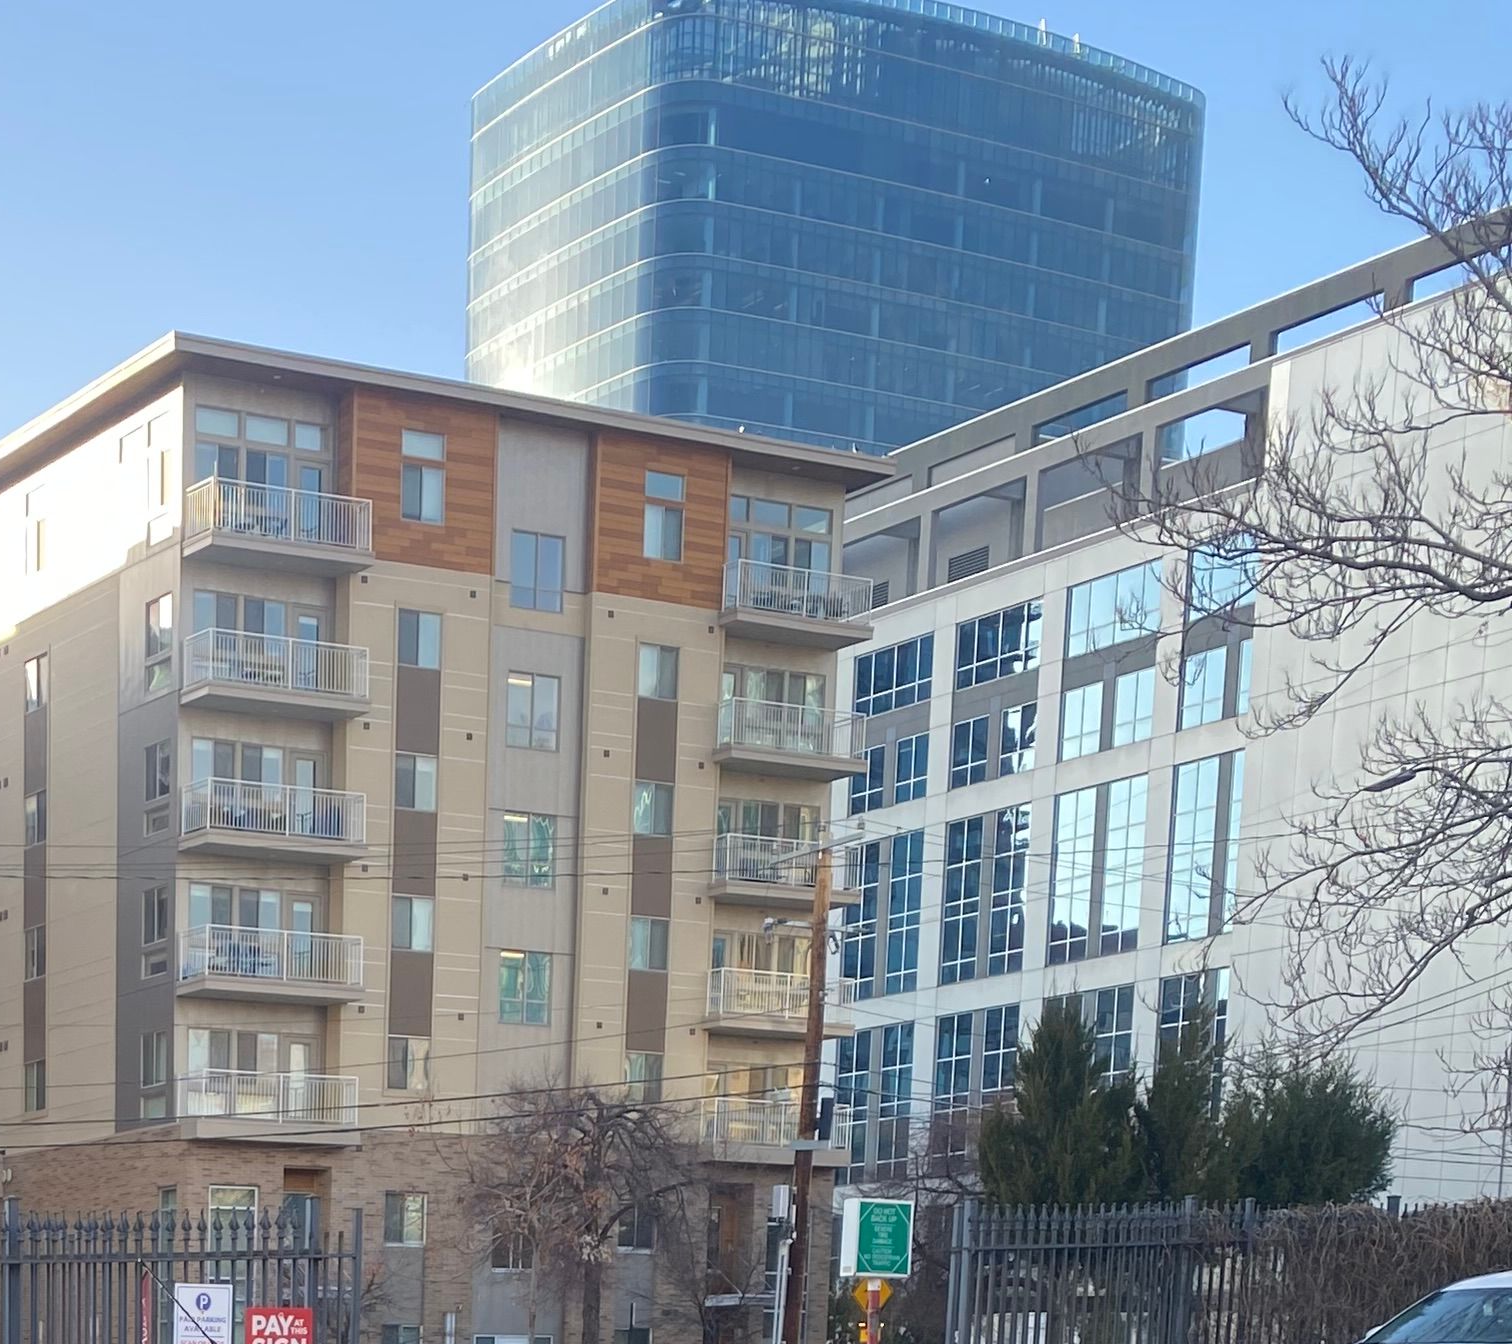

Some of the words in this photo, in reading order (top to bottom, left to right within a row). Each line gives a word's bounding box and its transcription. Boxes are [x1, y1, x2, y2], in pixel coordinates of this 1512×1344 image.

[196, 1316, 227, 1324] PARKING
[294, 1318, 304, 1326] AT
[184, 1325, 221, 1333] AVAABLE
[251, 1314, 295, 1336] PAY
[290, 1326, 308, 1335] THIS
